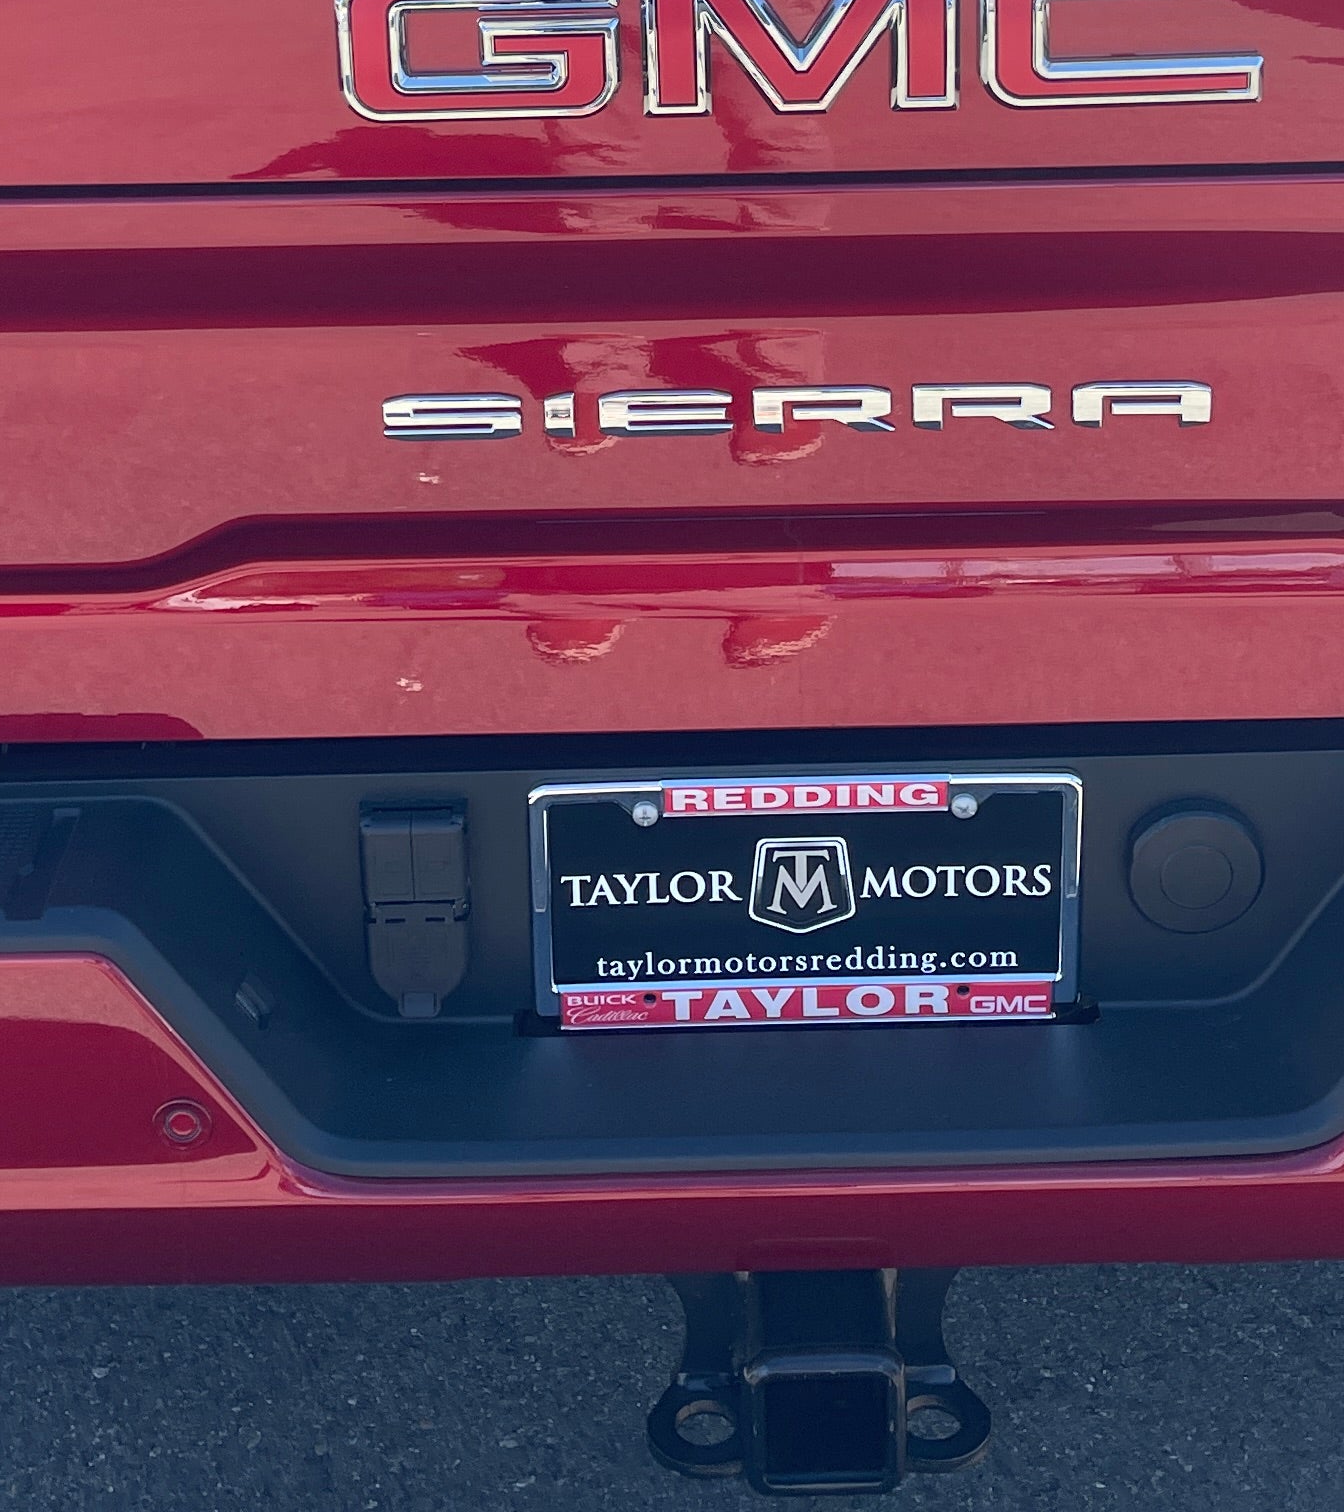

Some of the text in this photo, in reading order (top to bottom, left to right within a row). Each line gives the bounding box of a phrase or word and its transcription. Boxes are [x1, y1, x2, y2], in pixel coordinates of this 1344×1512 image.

[382, 380, 1212, 437] SIERRA
[671, 784, 940, 812] REDDING
[561, 870, 742, 907] TAYLOR
[860, 864, 1052, 899] MOTORS
[596, 945, 1019, 980] taylormotorsredding.com
[566, 1006, 649, 1024] Cadillac
[567, 994, 636, 1007] BUICK
[661, 984, 950, 1021] TAYLOR
[969, 993, 1048, 1014] GMC
